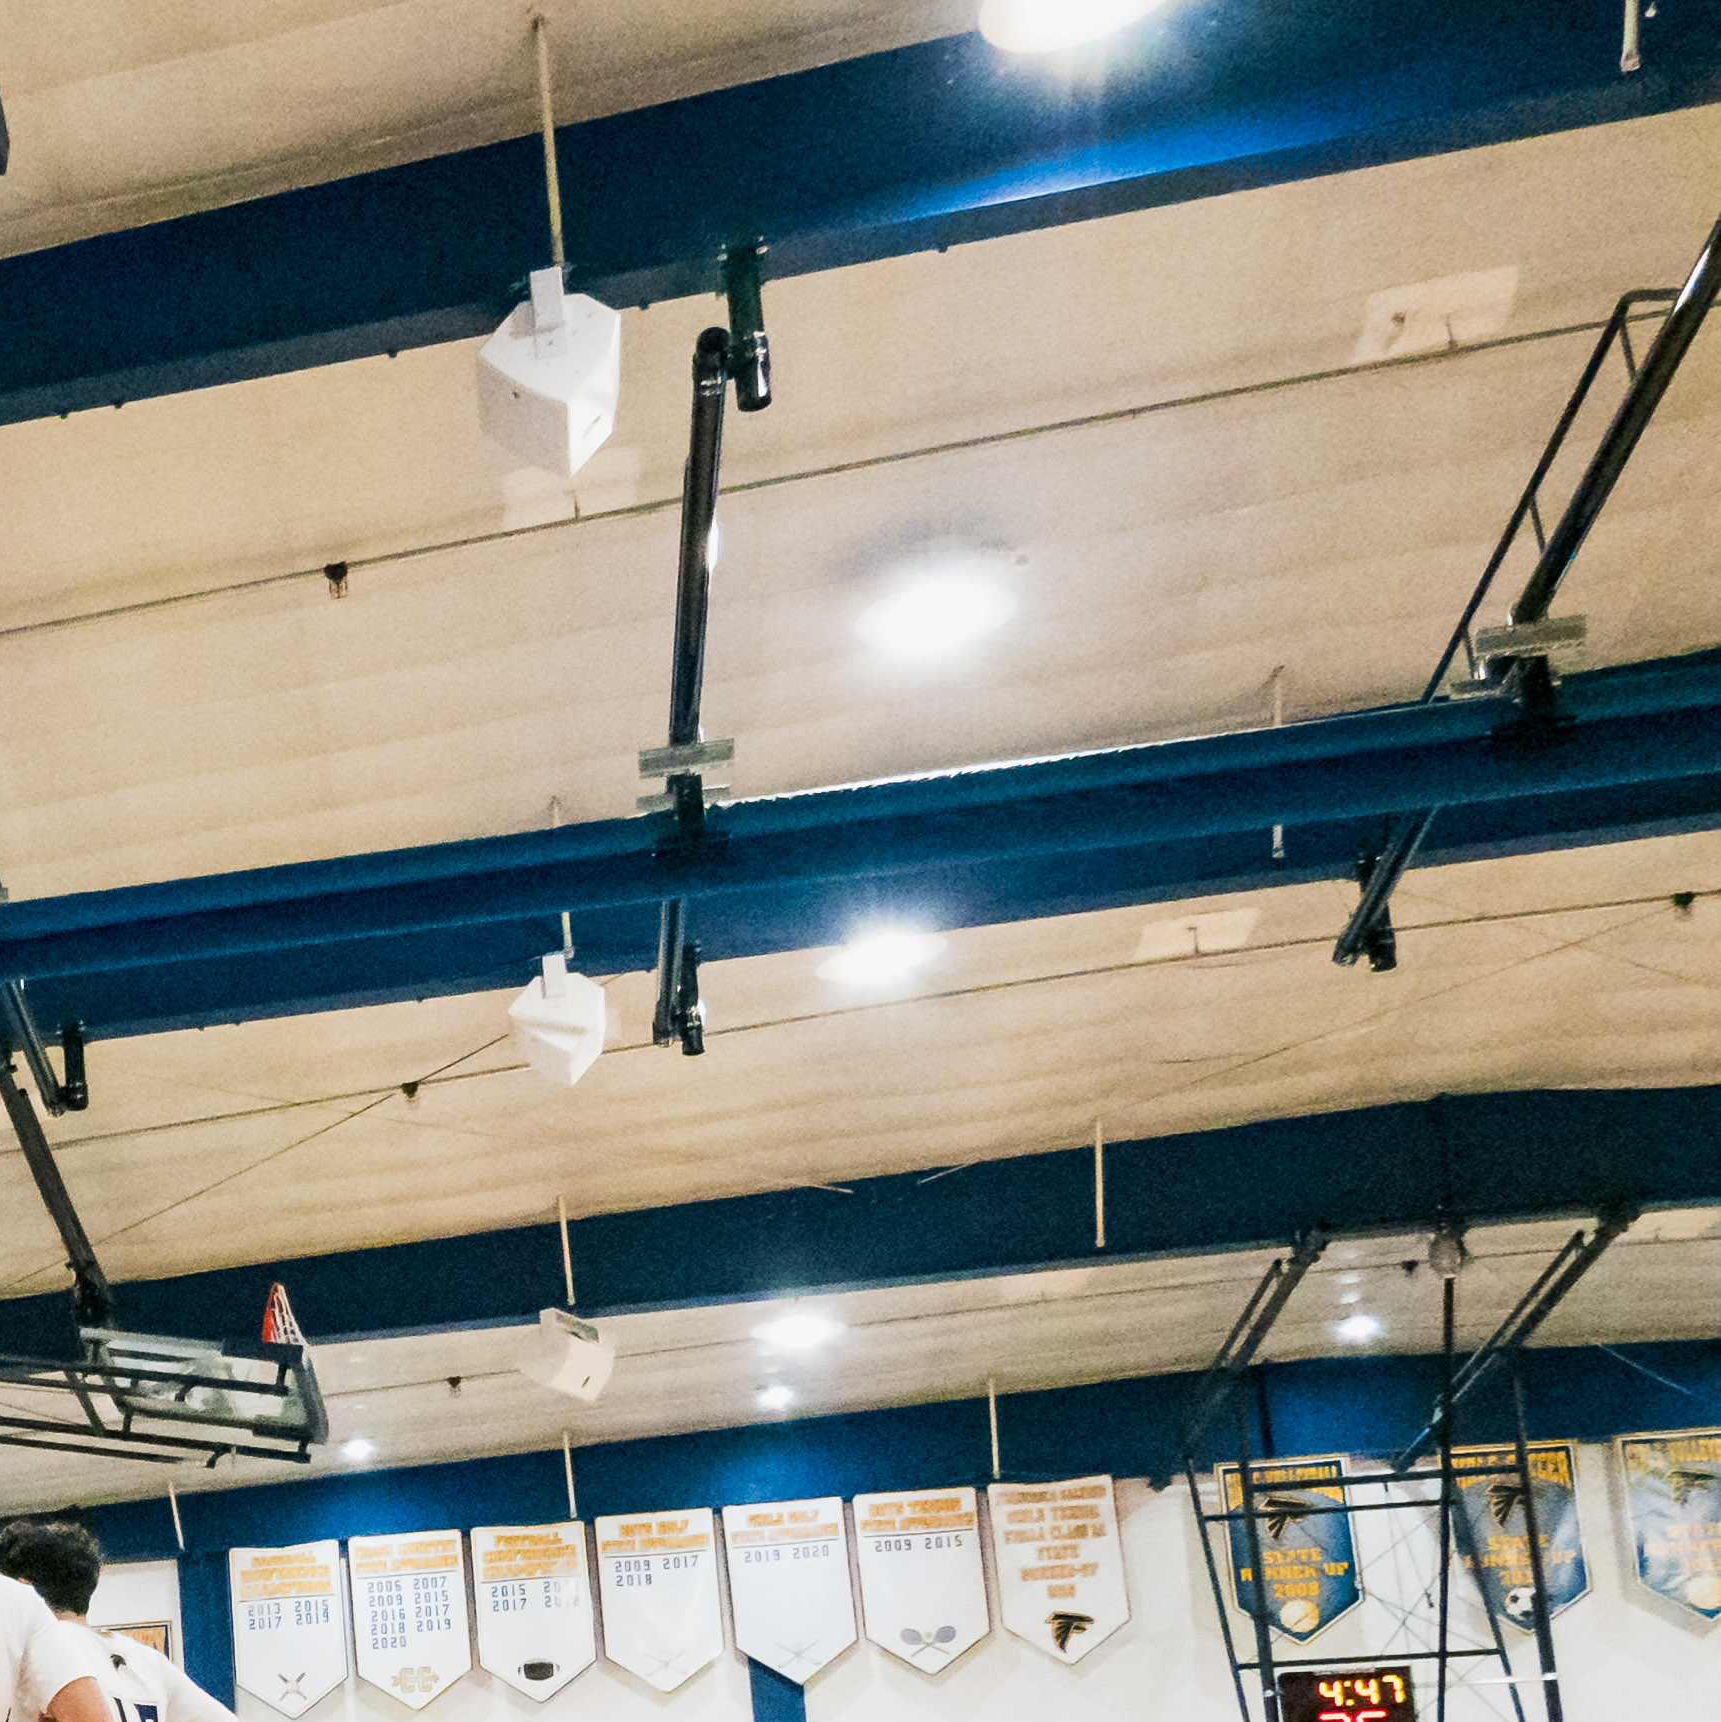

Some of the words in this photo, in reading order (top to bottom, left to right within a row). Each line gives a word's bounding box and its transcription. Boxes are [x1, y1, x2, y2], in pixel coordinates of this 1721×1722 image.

[875, 1539, 912, 1553] 2009
[925, 1534, 963, 1550] 2015
[745, 1549, 780, 1563] 2019
[793, 1545, 829, 1560] 2020
[615, 1560, 651, 1573] 2009
[663, 1555, 699, 1570] 2017
[368, 1580, 402, 1593] 2006
[413, 1576, 447, 1590] 2007
[616, 1574, 652, 1587] 2018
[369, 1594, 403, 1608] 2009
[414, 1590, 449, 1605] 2015
[491, 1584, 526, 1598] 2015
[371, 1608, 406, 1622] 2016
[415, 1604, 450, 1618] 2017
[493, 1598, 527, 1612] 2017
[249, 1617, 282, 1630] 2017
[371, 1622, 405, 1636] 2018
[416, 1618, 451, 1632] 2019
[372, 1636, 407, 1650] 2020
[1318, 1675, 1405, 1707] 4:47
